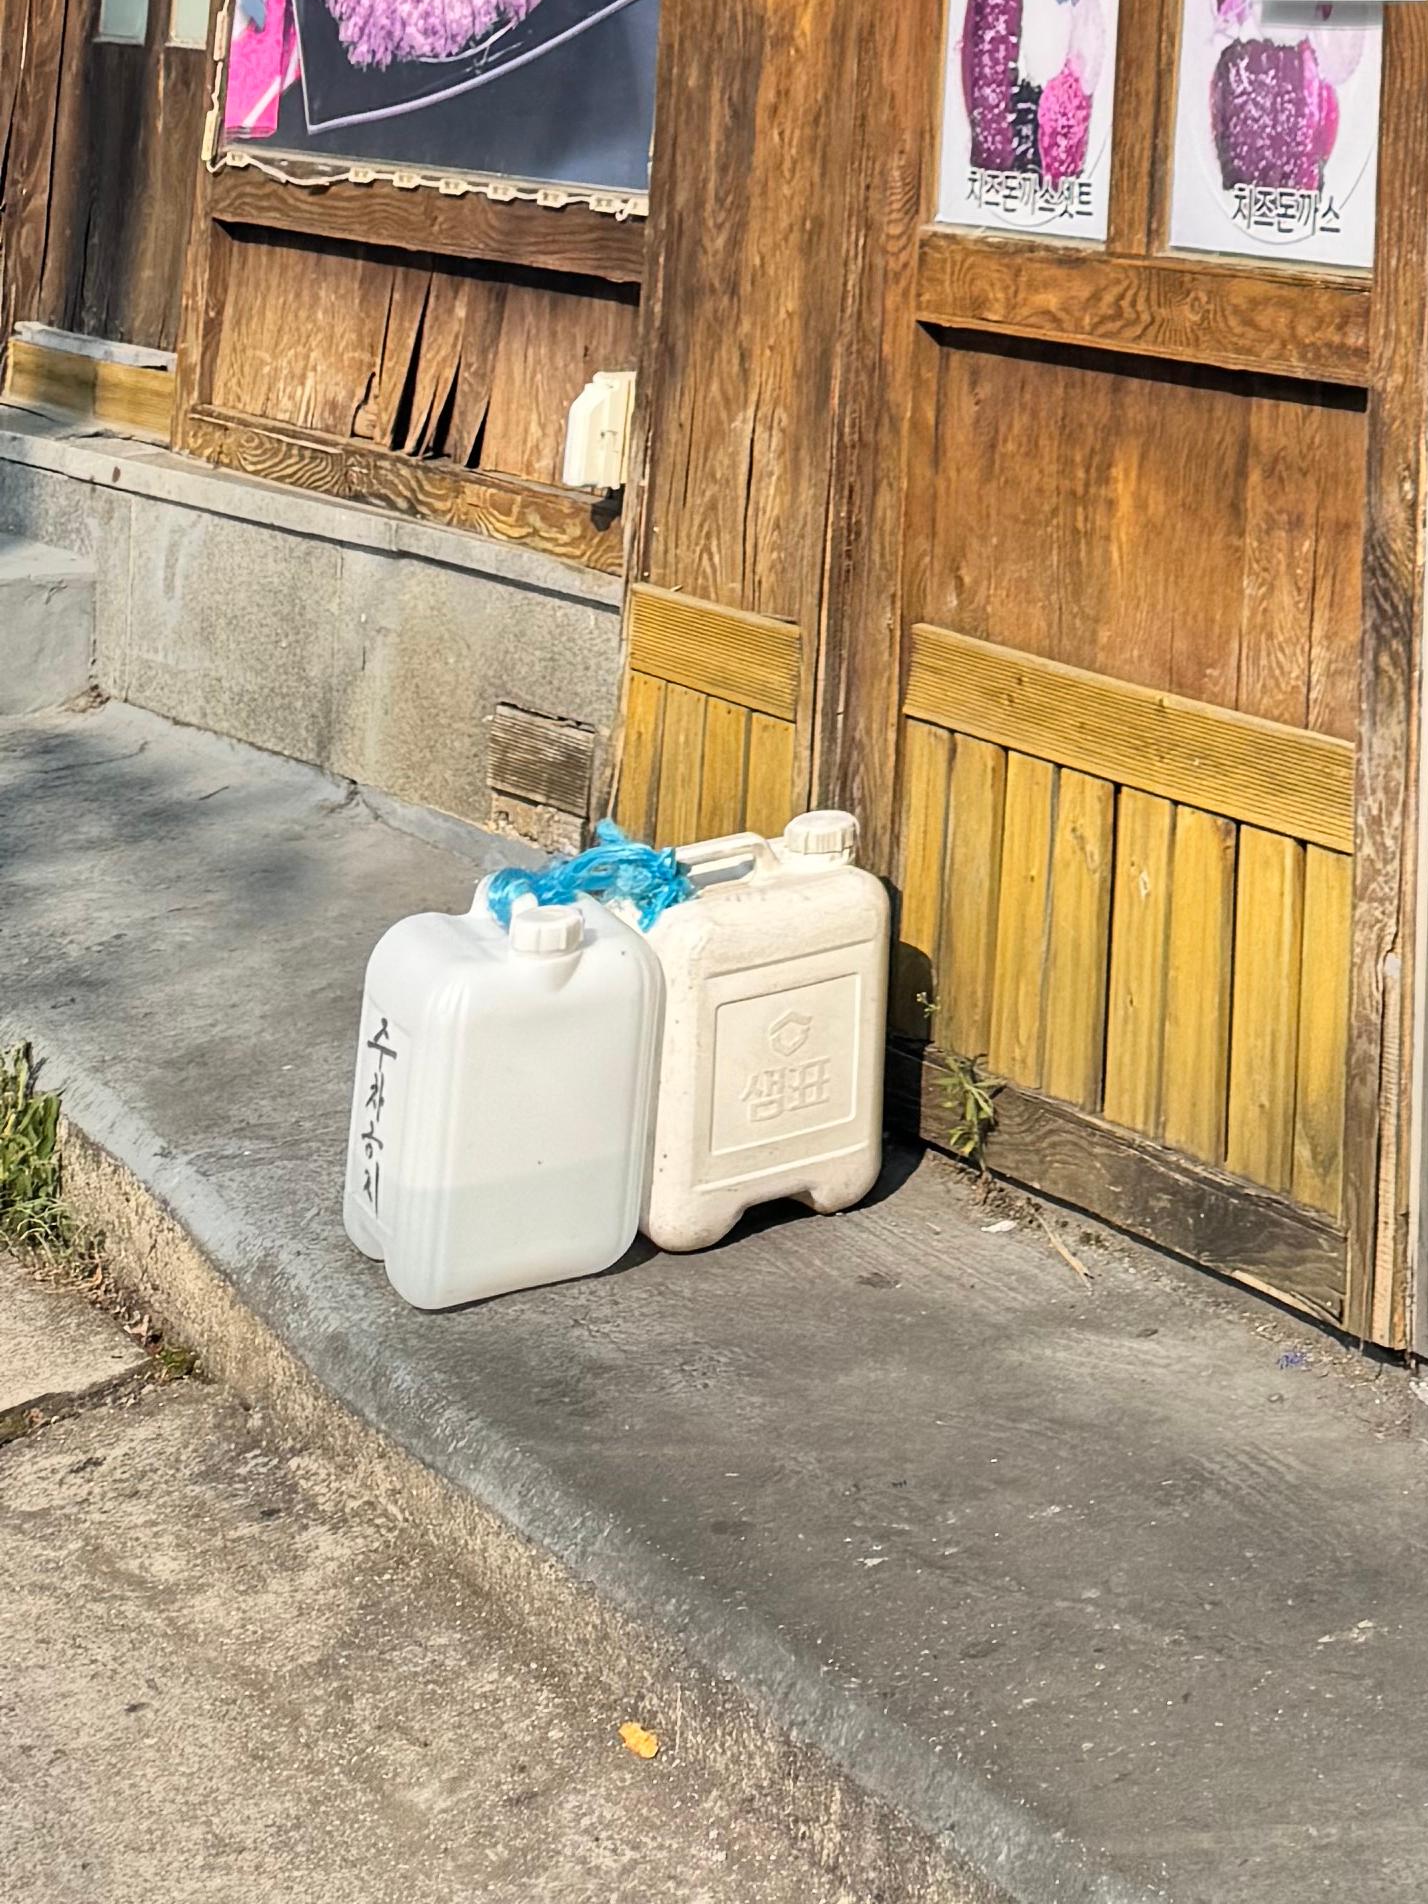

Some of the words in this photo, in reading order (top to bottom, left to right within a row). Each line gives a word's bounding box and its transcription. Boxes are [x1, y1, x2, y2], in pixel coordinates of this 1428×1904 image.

[966, 170, 1093, 219] 치즈돈까스셋트
[1232, 186, 1341, 237] 치즈돈까스
[740, 1055, 831, 1122] 샘표
